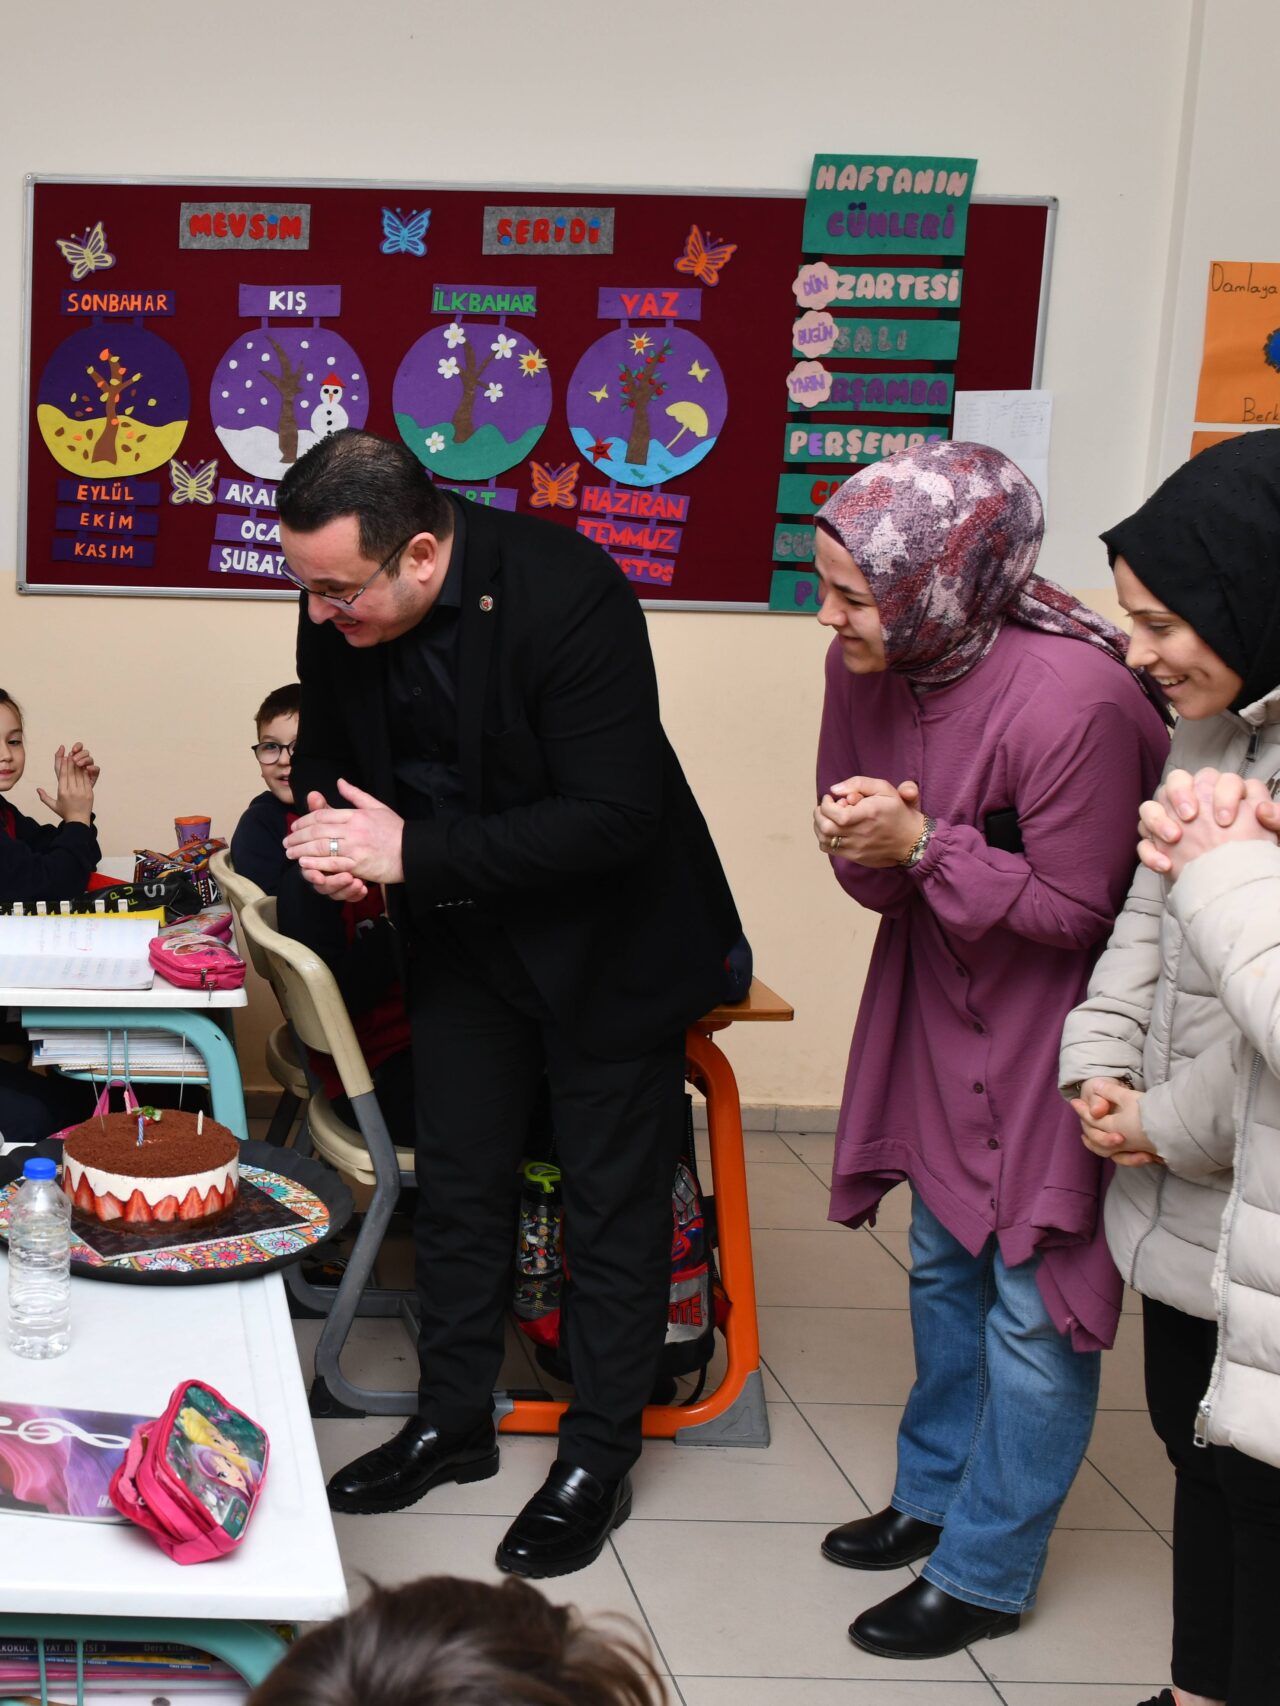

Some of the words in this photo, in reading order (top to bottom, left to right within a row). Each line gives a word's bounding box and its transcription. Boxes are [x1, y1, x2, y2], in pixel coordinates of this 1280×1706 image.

[815, 164, 968, 197] HAFTANIN
[189, 214, 302, 240] MEVSİM
[803, 274, 828, 296] DÜN
[837, 270, 959, 301] ZARTESİ
[67, 293, 167, 312] SONBAHAR
[269, 291, 307, 315] KIŞ
[433, 286, 537, 313] İLKBAHAR
[620, 292, 679, 317] YAZ
[798, 322, 834, 346] BUGÜN
[834, 326, 908, 352] SALI
[830, 378, 948, 411] RŞAMBA
[77, 482, 134, 501] EYLÜL
[225, 484, 277, 507] ARAL
[582, 487, 685, 519] HAZİRAN
[80, 512, 133, 529] EKİM
[241, 520, 281, 543] OCA
[577, 519, 678, 550] TEMMUZ
[74, 542, 134, 559] KASIM
